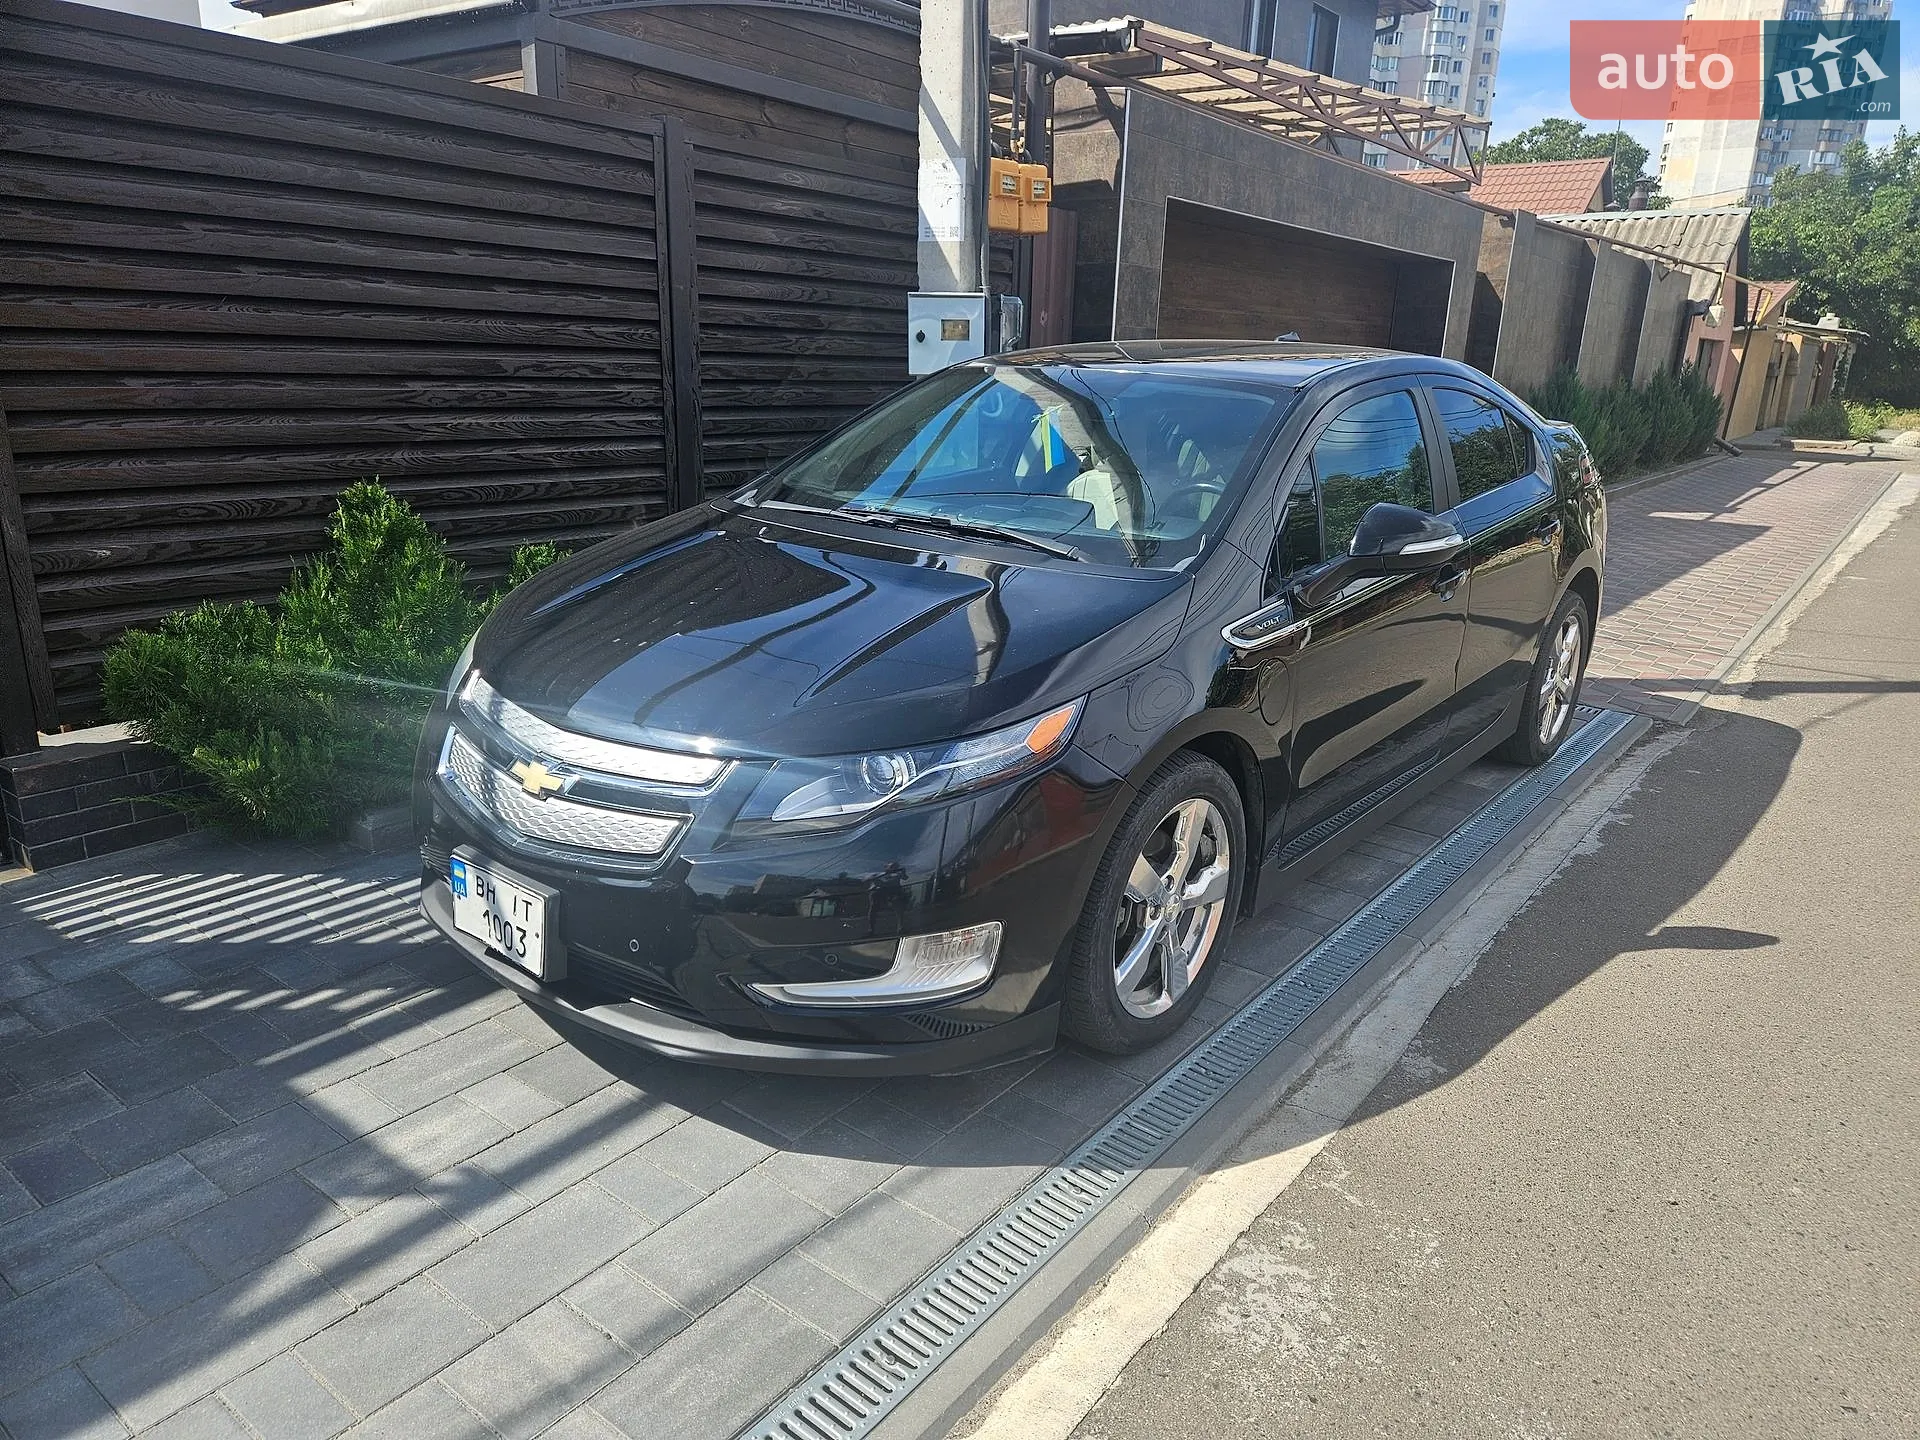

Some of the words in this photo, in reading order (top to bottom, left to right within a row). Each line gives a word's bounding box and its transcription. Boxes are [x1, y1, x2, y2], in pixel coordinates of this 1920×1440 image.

[1256, 615, 1281, 630] VOLT
[454, 882, 466, 896] UA
[475, 875, 496, 904] BH
[513, 895, 532, 922] IT
[482, 909, 526, 958] 1003
